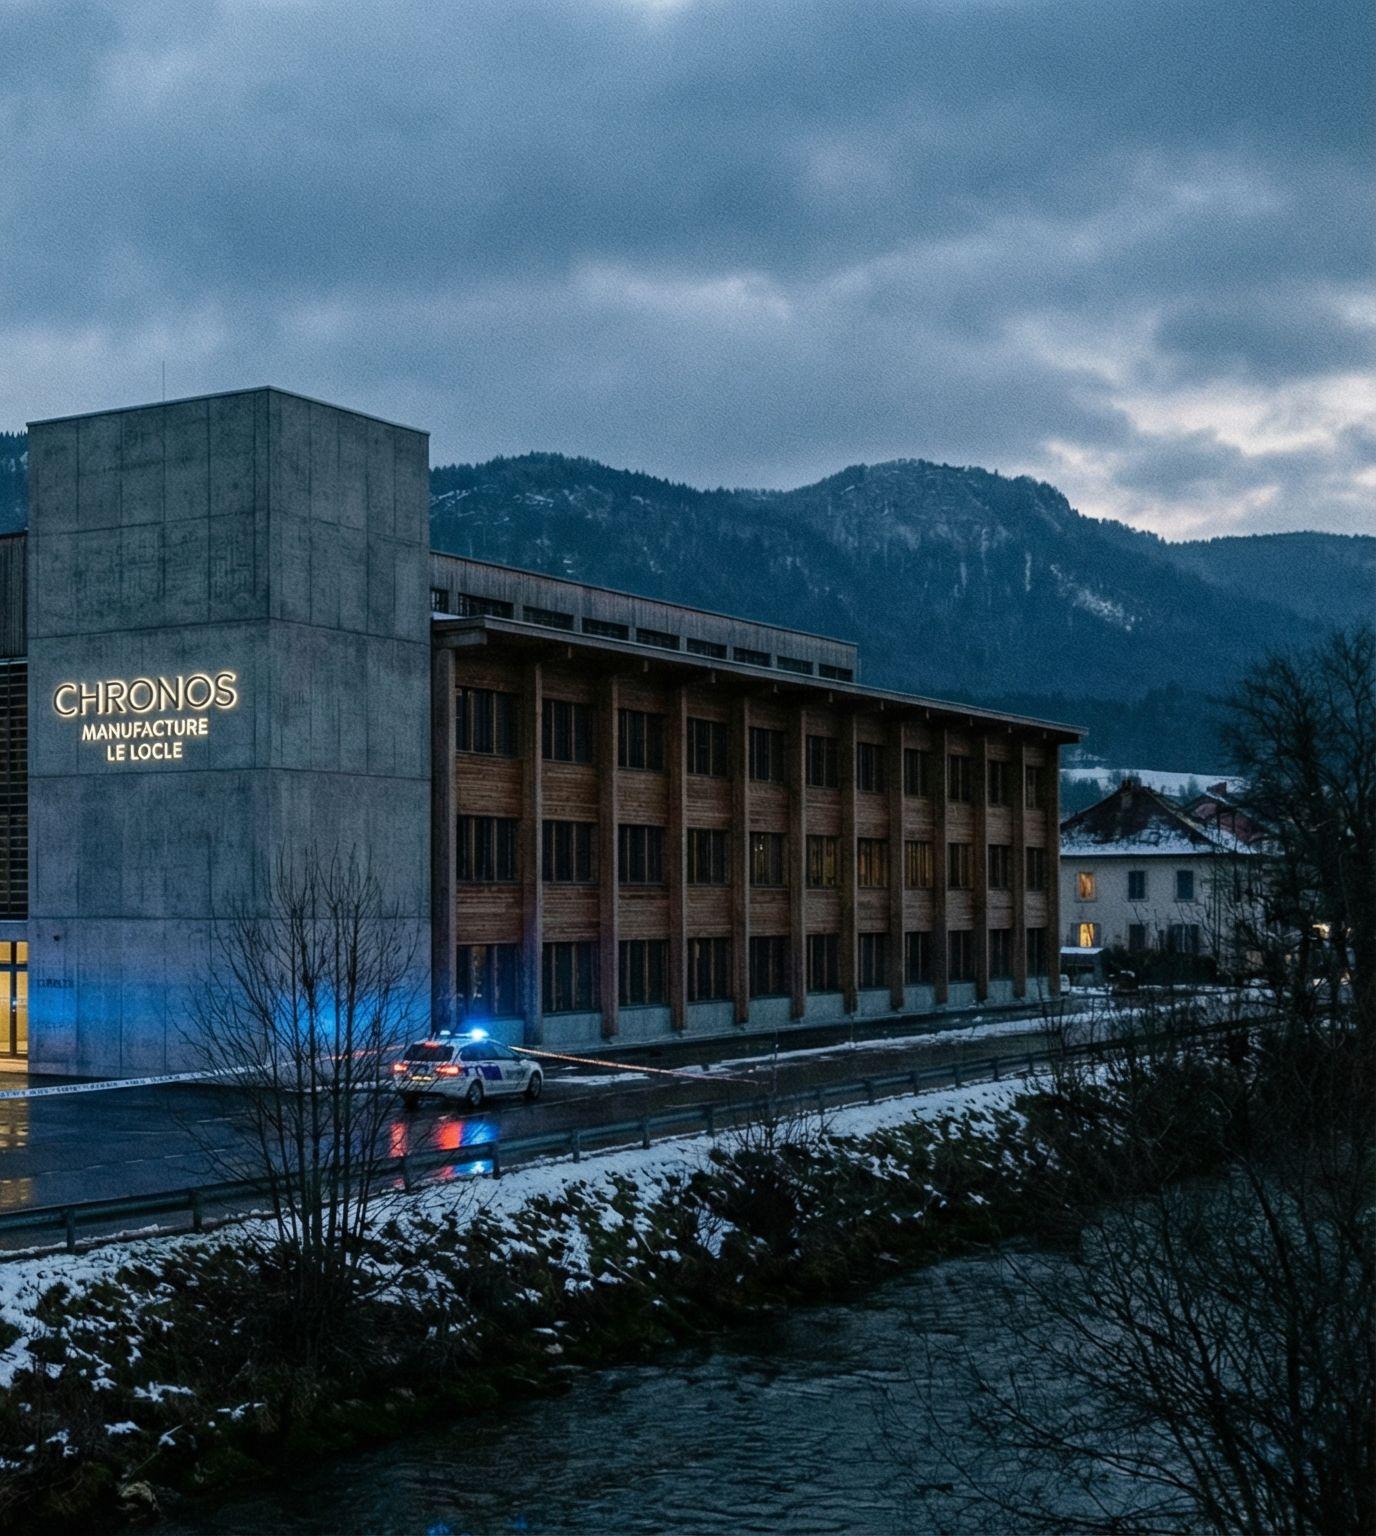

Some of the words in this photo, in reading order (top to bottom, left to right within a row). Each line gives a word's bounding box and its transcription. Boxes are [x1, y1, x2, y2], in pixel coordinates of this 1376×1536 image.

[54, 672, 236, 716] CHRONOS
[82, 718, 209, 741] MANUFACTURE
[107, 745, 125, 762] LE
[130, 742, 183, 760] LOCLE
